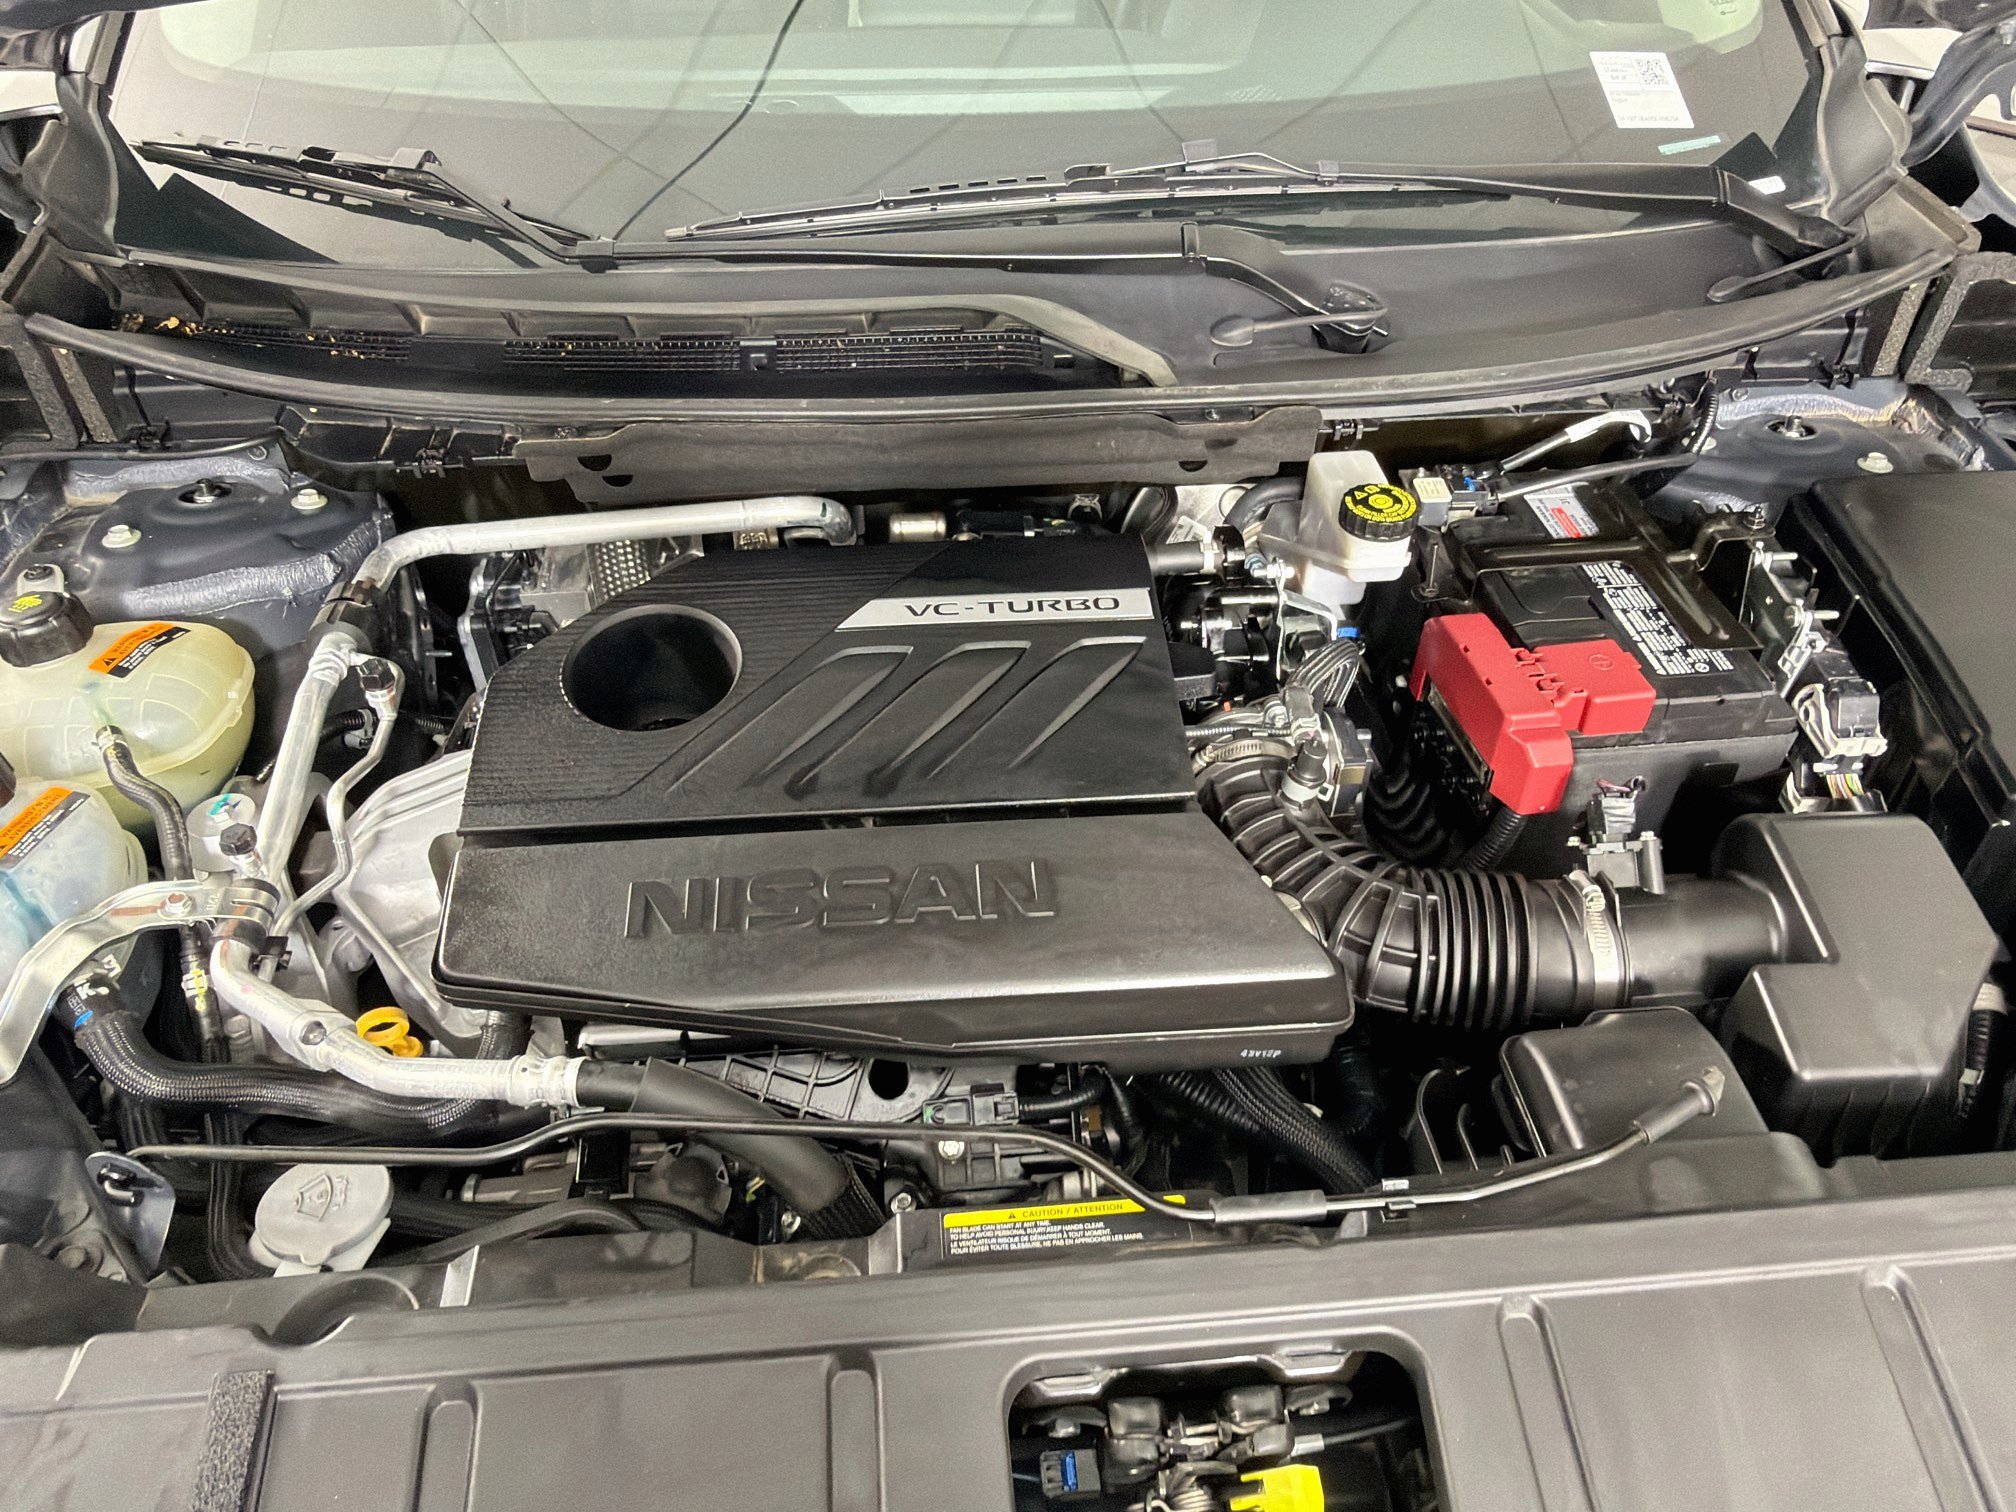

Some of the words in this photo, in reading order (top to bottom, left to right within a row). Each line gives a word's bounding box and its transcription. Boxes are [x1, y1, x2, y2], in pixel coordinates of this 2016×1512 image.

[904, 597, 1120, 617] VC-TURBO
[624, 859, 1056, 938] NISSAN
[1022, 1207, 1063, 1218] CAUTION
[1074, 1204, 1123, 1214] ATTENTION
[959, 1237, 997, 1247] VENTILATEUR
[998, 1236, 1019, 1244] RISQUE
[1085, 1228, 1112, 1236] MOMENT.
[994, 1228, 1025, 1237] PERSONAL
[1074, 1235, 1111, 1244] APPROCHER
